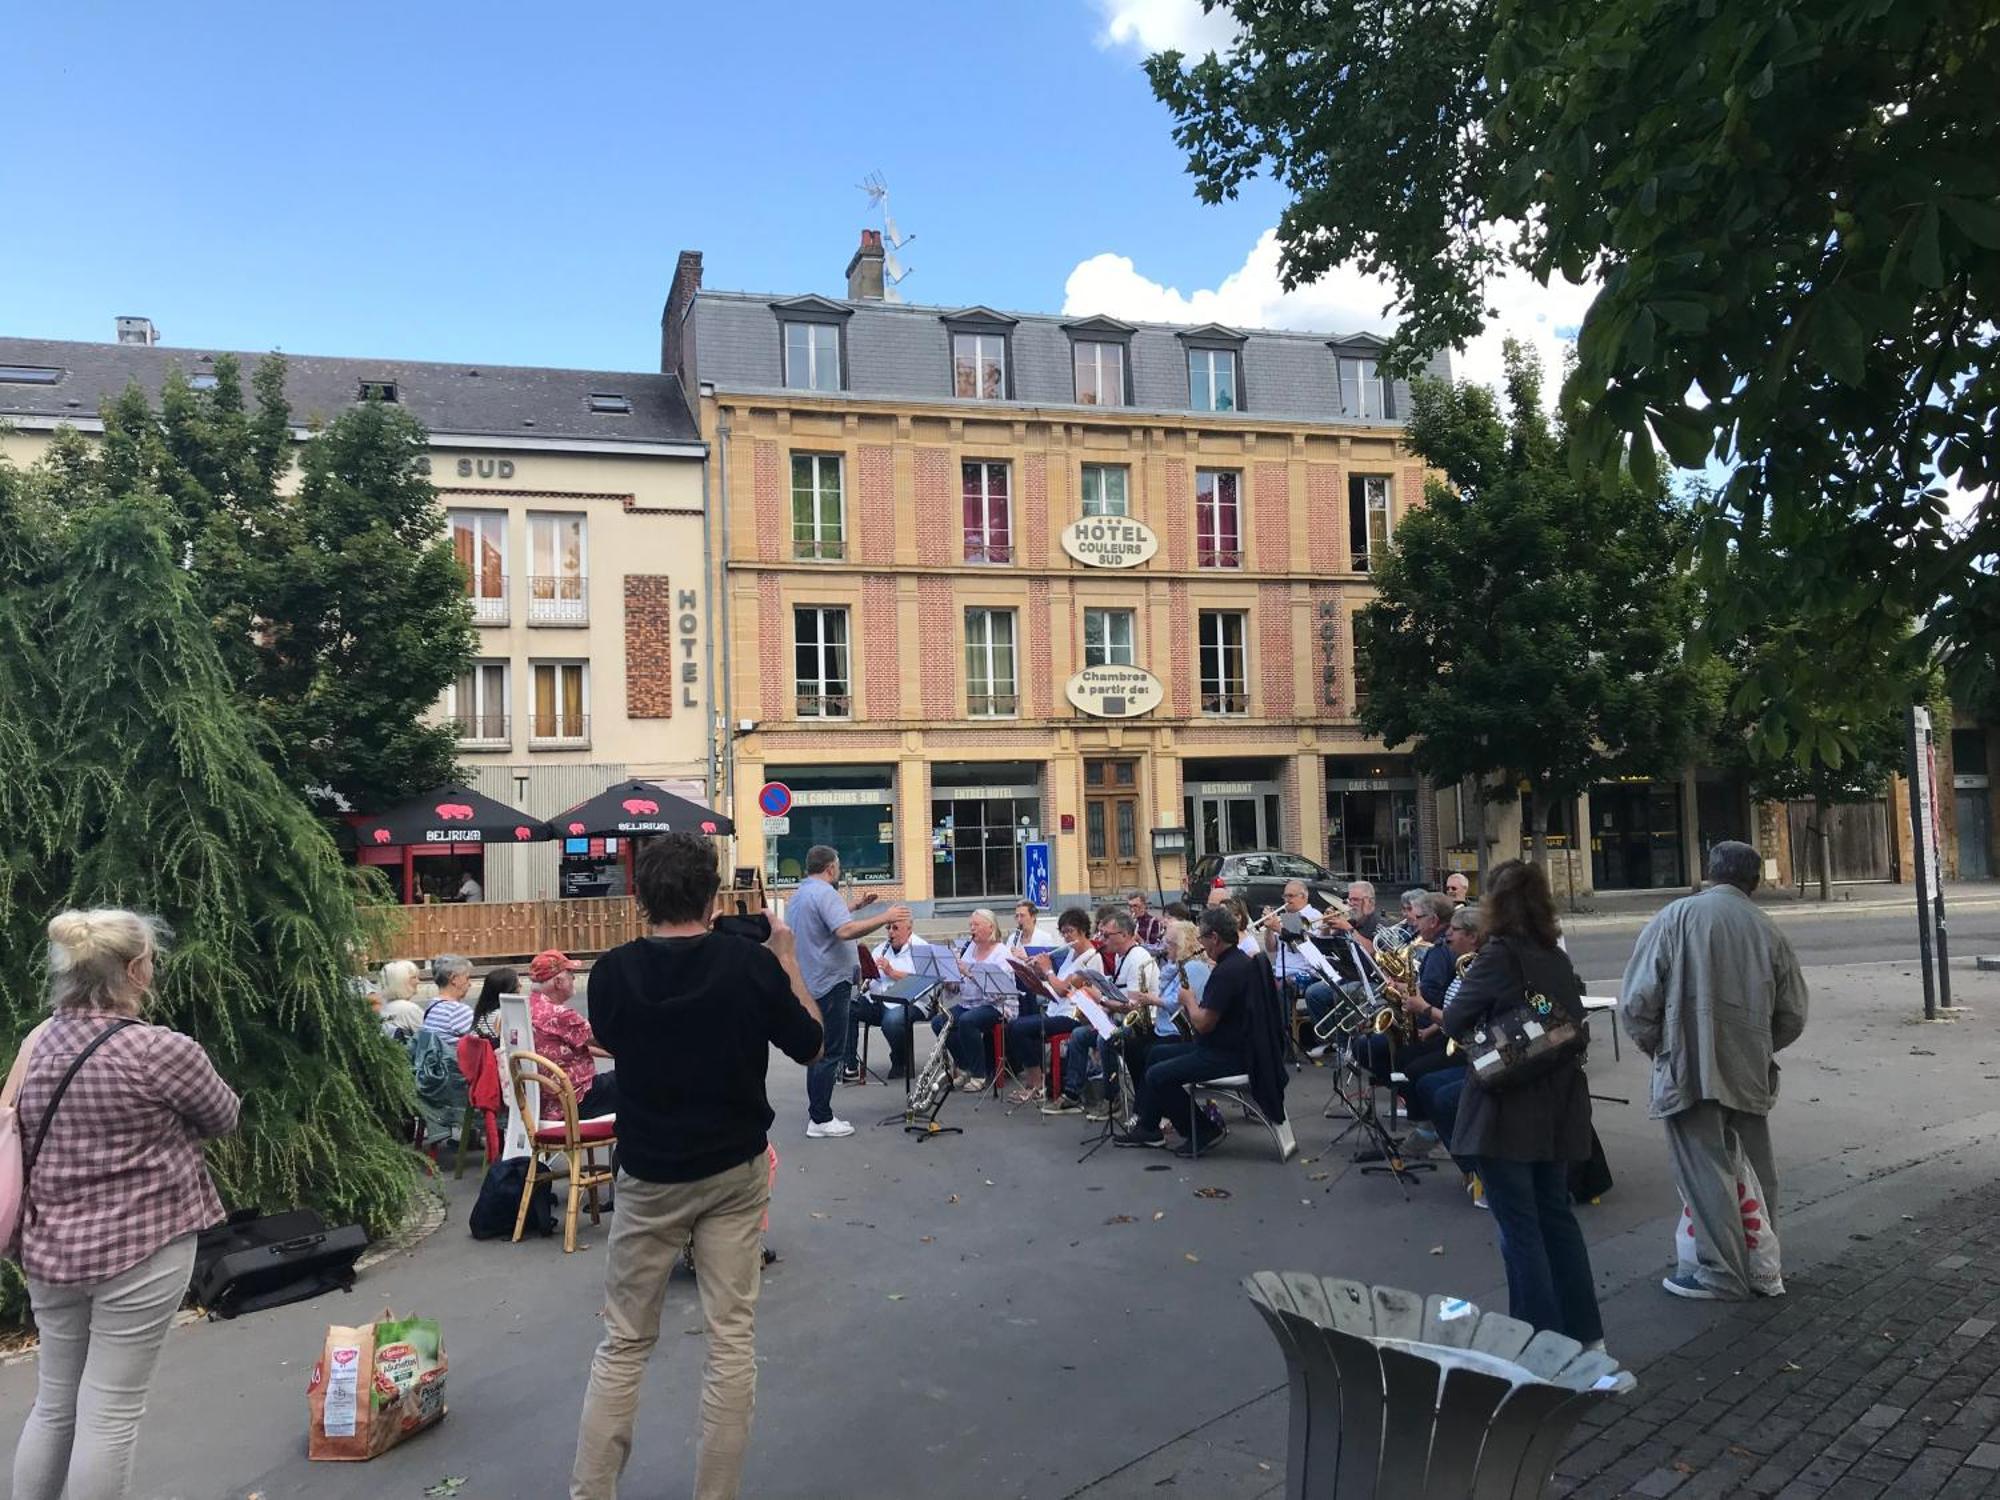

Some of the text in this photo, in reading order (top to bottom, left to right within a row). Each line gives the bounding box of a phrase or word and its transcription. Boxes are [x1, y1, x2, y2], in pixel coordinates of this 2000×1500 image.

[457, 458, 515, 479] SUD
[1075, 524, 1148, 542] HOTEL
[1079, 542, 1142, 555] COULEURS
[1098, 554, 1123, 565] SUD
[678, 589, 698, 708] HOTEL
[1082, 671, 1148, 682] Chambres
[1089, 684, 1126, 696] partir
[861, 791, 880, 803] SUD
